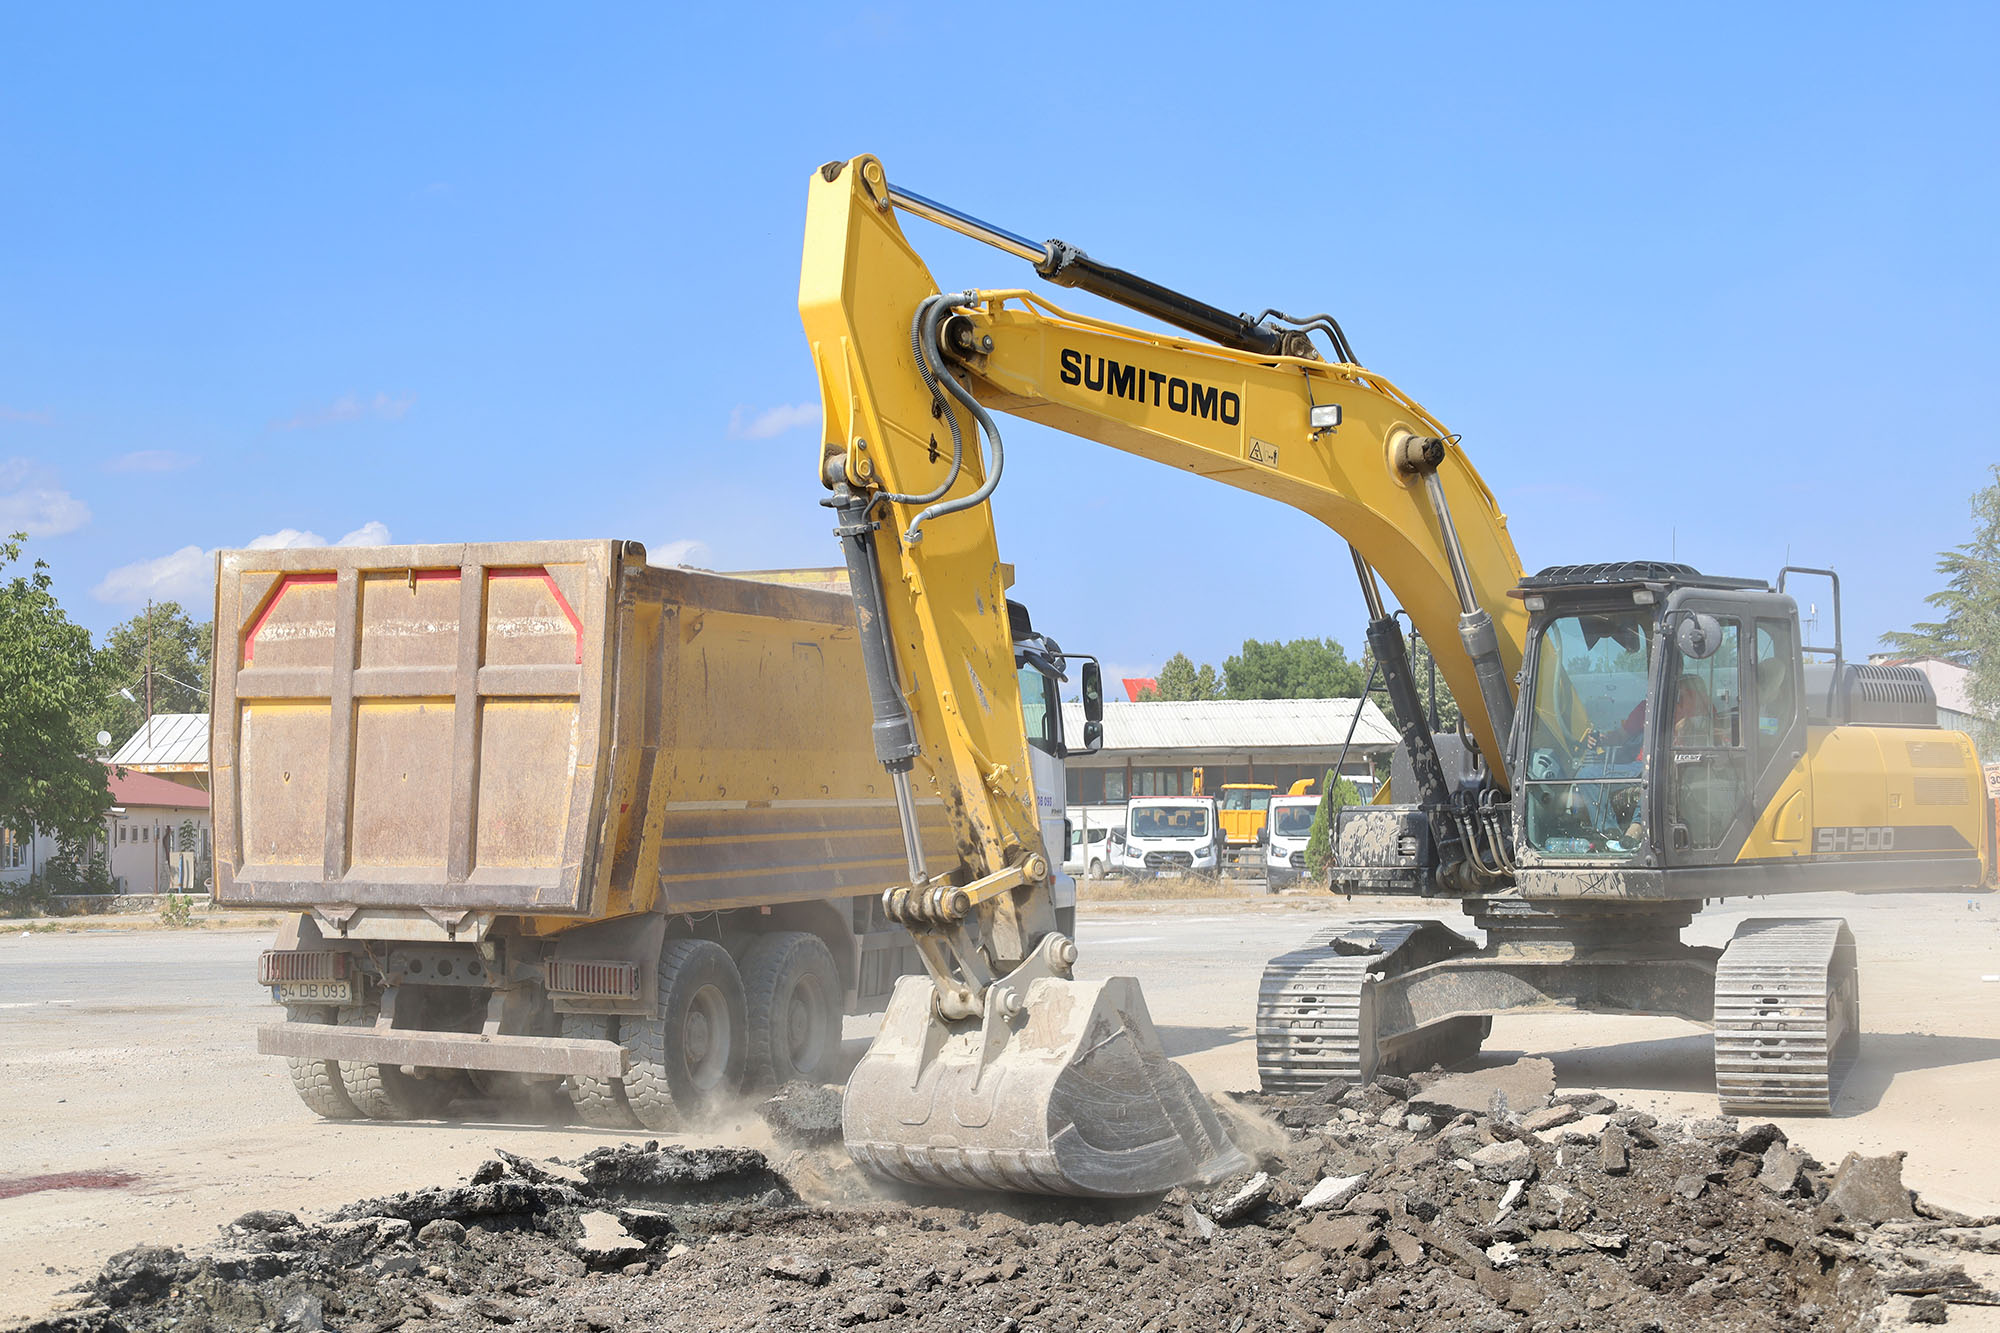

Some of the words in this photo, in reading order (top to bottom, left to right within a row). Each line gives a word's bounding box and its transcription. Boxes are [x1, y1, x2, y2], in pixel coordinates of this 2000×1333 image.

[1060, 348, 1240, 426] SUMITOMO
[280, 983, 295, 997] 54
[300, 983, 318, 998] DB
[322, 984, 347, 998] 093
